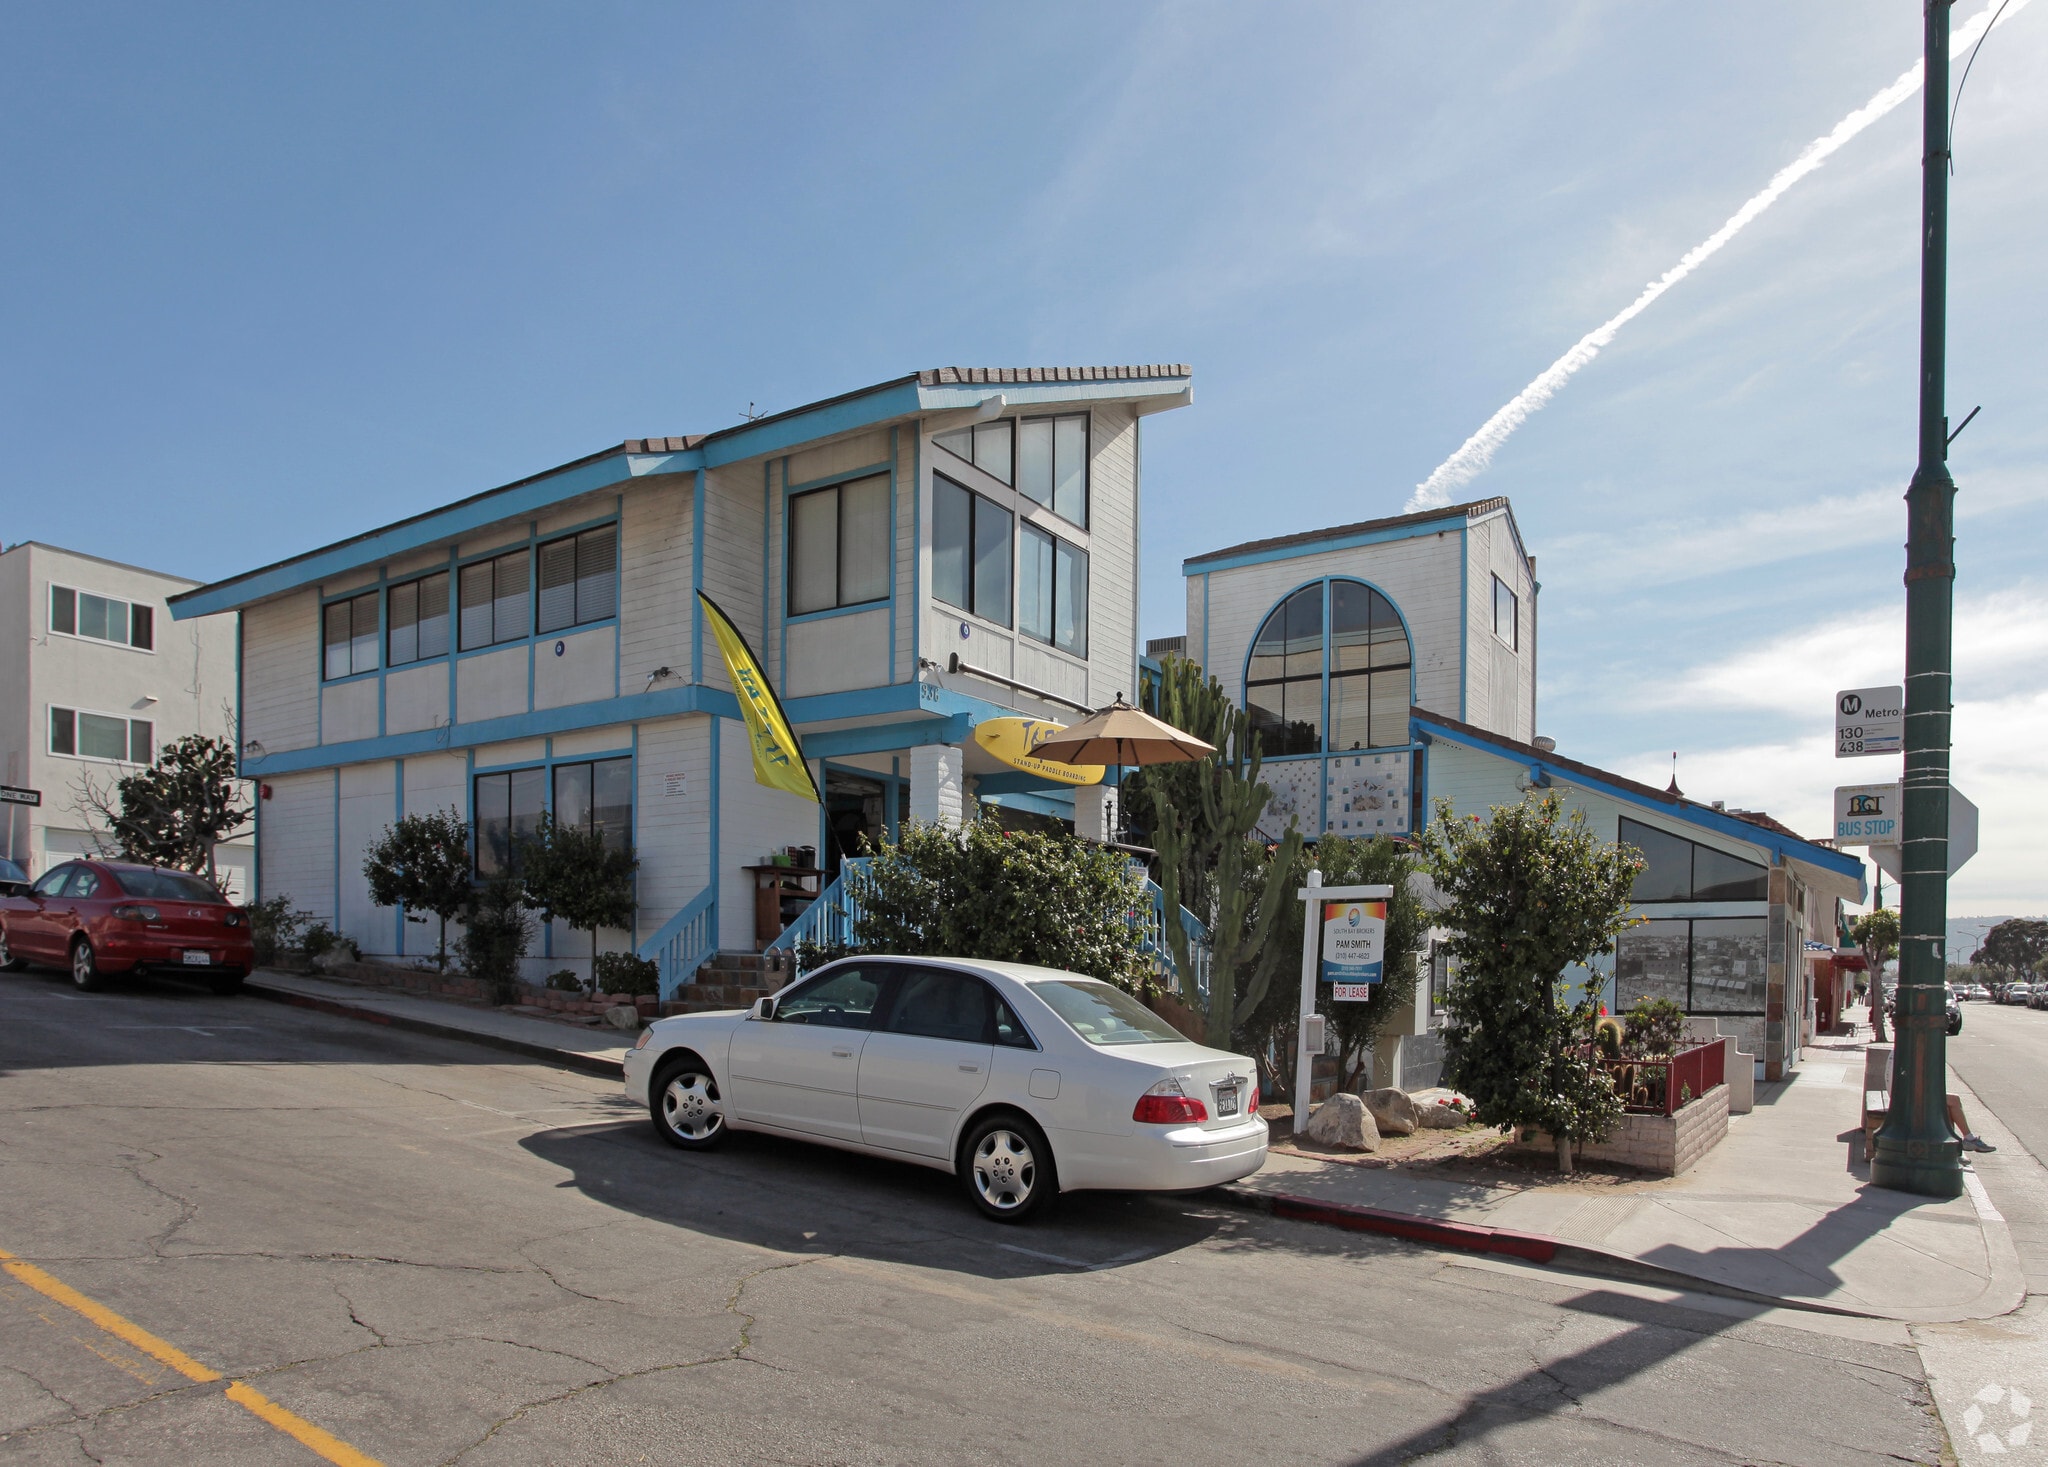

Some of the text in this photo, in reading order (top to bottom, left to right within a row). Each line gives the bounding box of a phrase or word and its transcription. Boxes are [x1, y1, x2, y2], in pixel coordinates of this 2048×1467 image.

[921, 684, 940, 702] 936
[1865, 708, 1899, 719] Metro
[1838, 727, 1864, 740] 130
[1839, 741, 1864, 753] 438
[1013, 758, 1087, 782] STAND-UP PADDLE BOARDING
[1, 790, 35, 801] ONE WAY
[1838, 819, 1895, 837] BUS STOP
[1335, 940, 1371, 949] PAM SMITH
[1335, 987, 1368, 998] FOR LEASE
